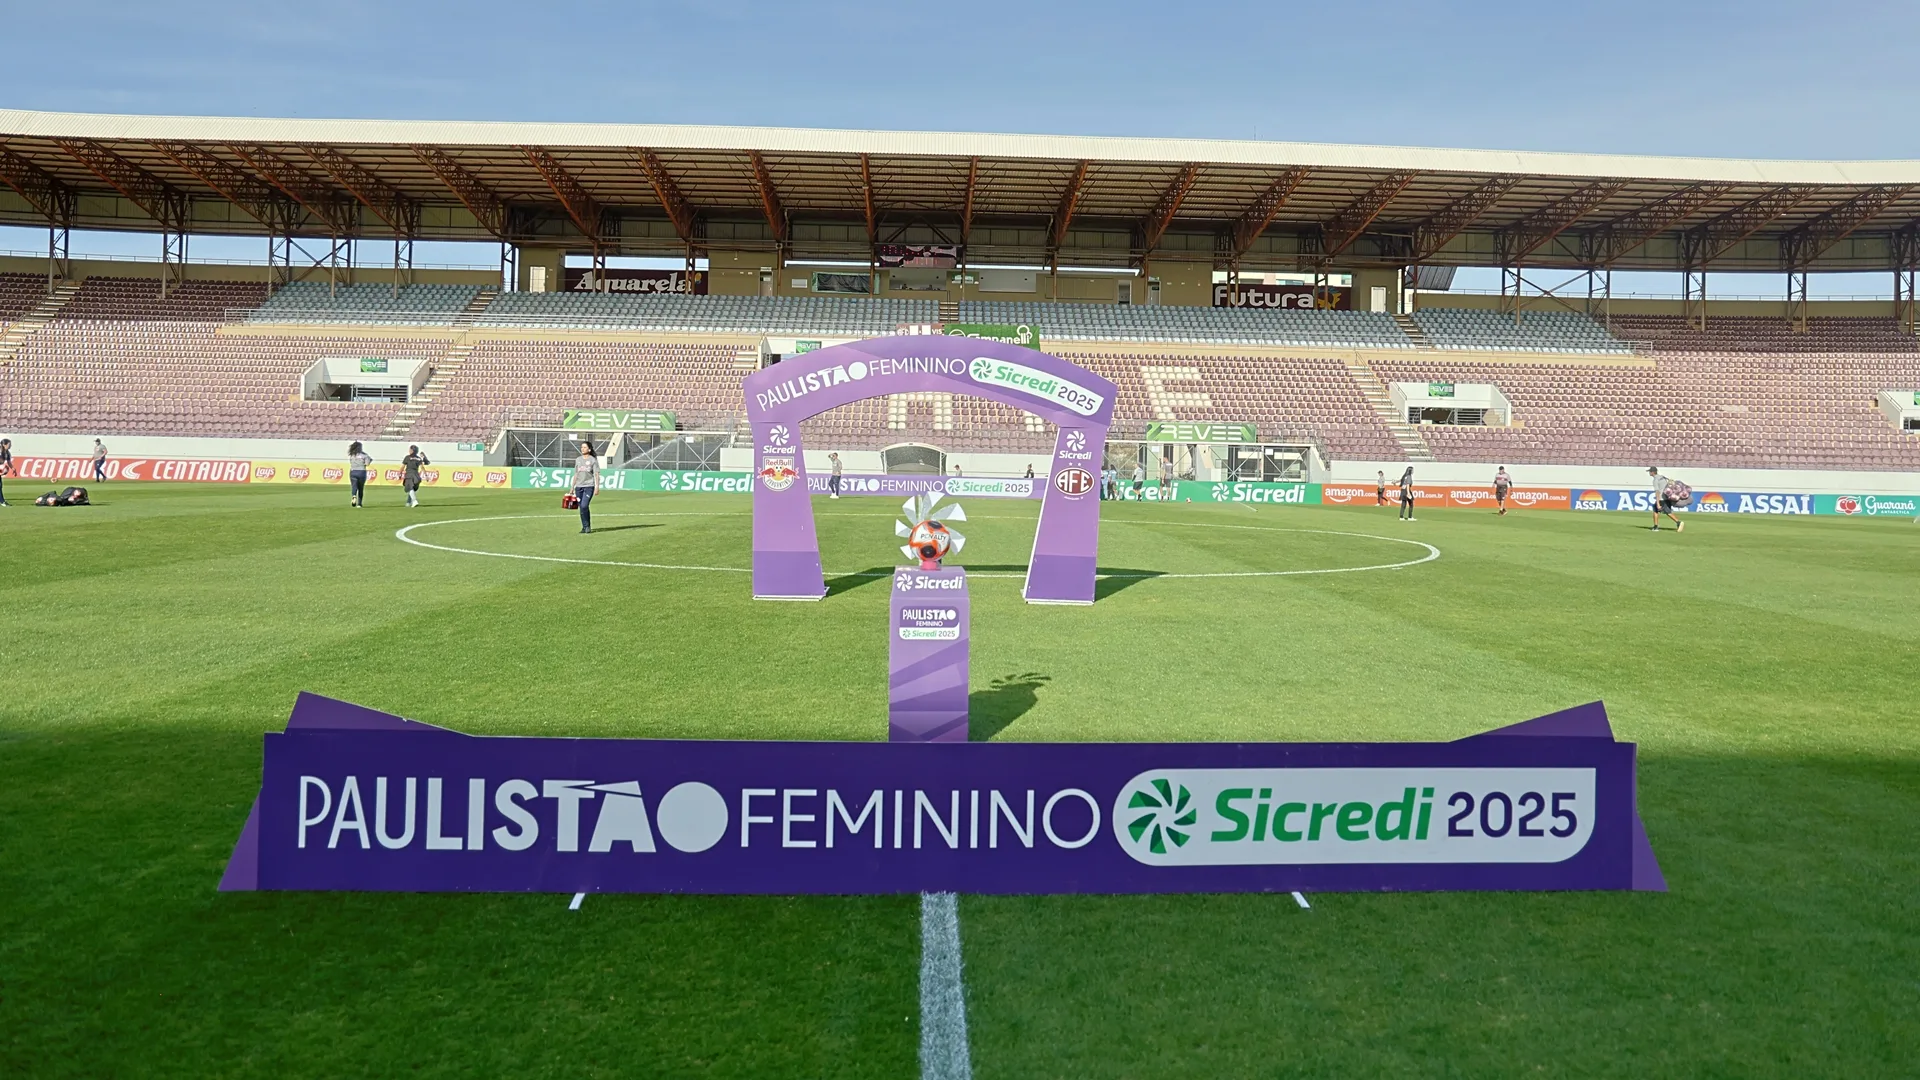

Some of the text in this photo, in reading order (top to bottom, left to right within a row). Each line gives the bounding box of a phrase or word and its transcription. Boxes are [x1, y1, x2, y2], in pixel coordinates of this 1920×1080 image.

[869, 357, 966, 376] FEMININO
[994, 365, 1058, 395] Sicredi
[1057, 386, 1096, 411] 2025
[762, 445, 797, 454] Sicredi
[1058, 450, 1093, 460] Sicredi
[152, 460, 250, 482] CENTAURO
[881, 479, 943, 492] FEMININO
[962, 481, 1003, 492] Sicredi
[1004, 483, 1030, 493] 2025
[1057, 470, 1090, 493] AFE
[1232, 483, 1305, 503] Sicredi
[914, 576, 963, 590] Sicredi
[740, 788, 1101, 849] FEMININO
[1210, 786, 1434, 842] Sicredi
[1446, 791, 1579, 837] 2025
